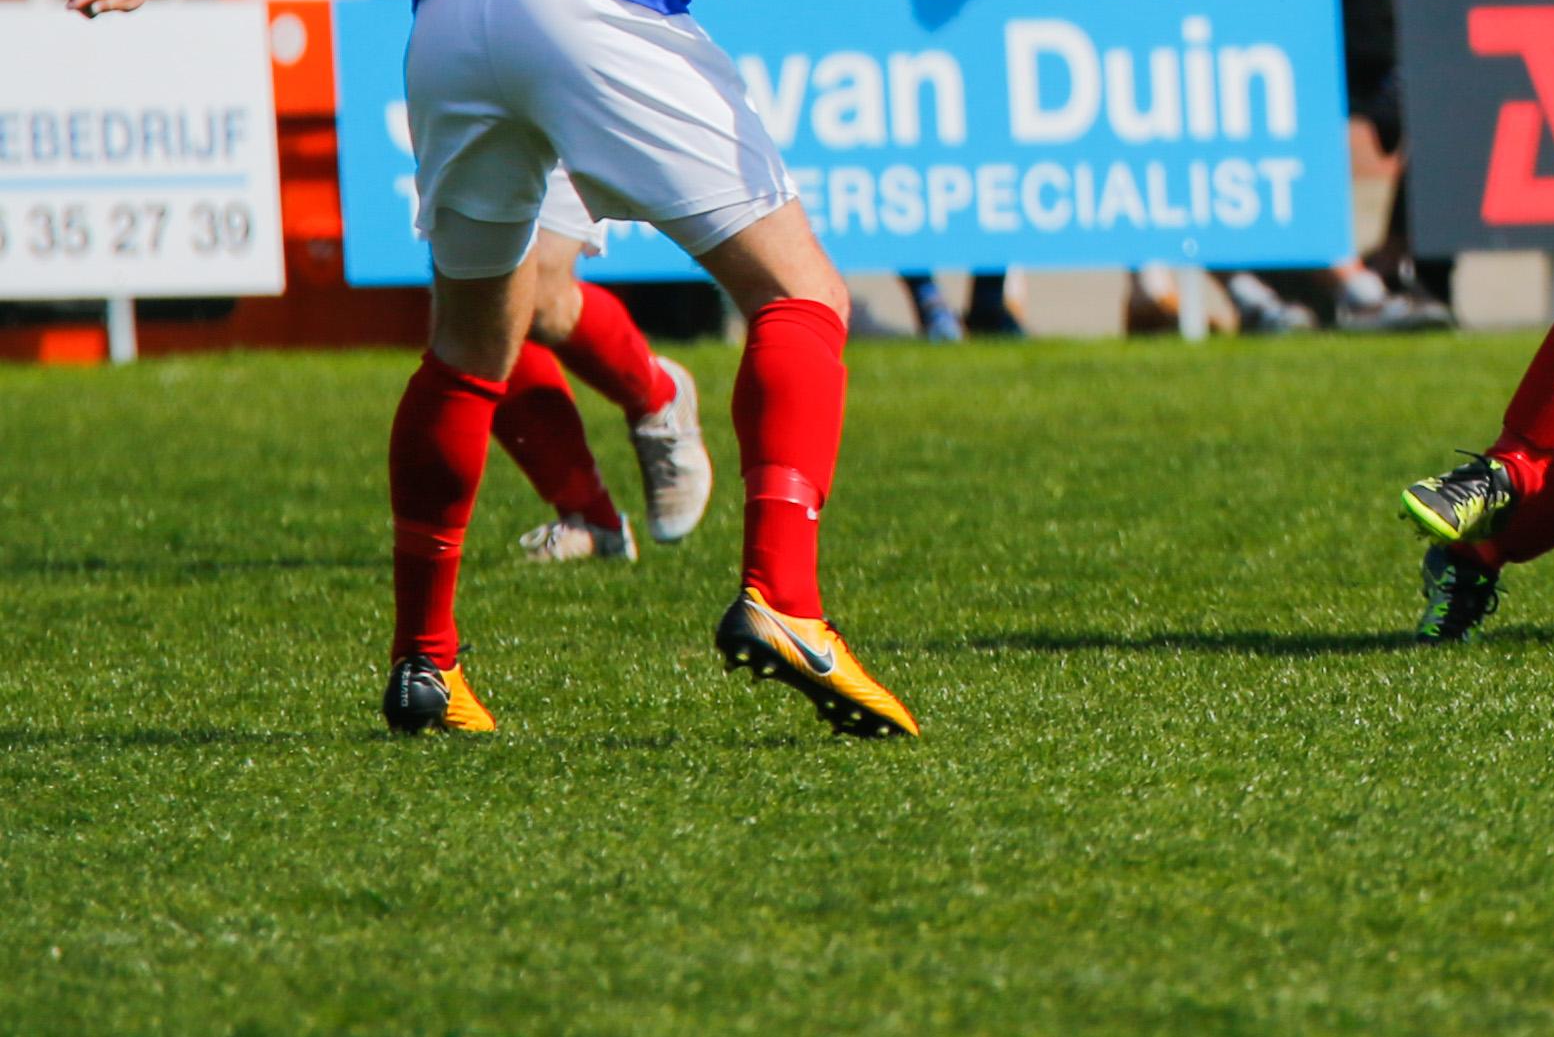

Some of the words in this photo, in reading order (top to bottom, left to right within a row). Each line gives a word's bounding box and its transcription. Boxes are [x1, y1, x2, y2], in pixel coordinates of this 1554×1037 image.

[738, 48, 968, 148] van
[1005, 16, 1300, 145] Duin
[27, 203, 91, 259] 35
[107, 202, 168, 257] 27
[190, 200, 252, 256] 39
